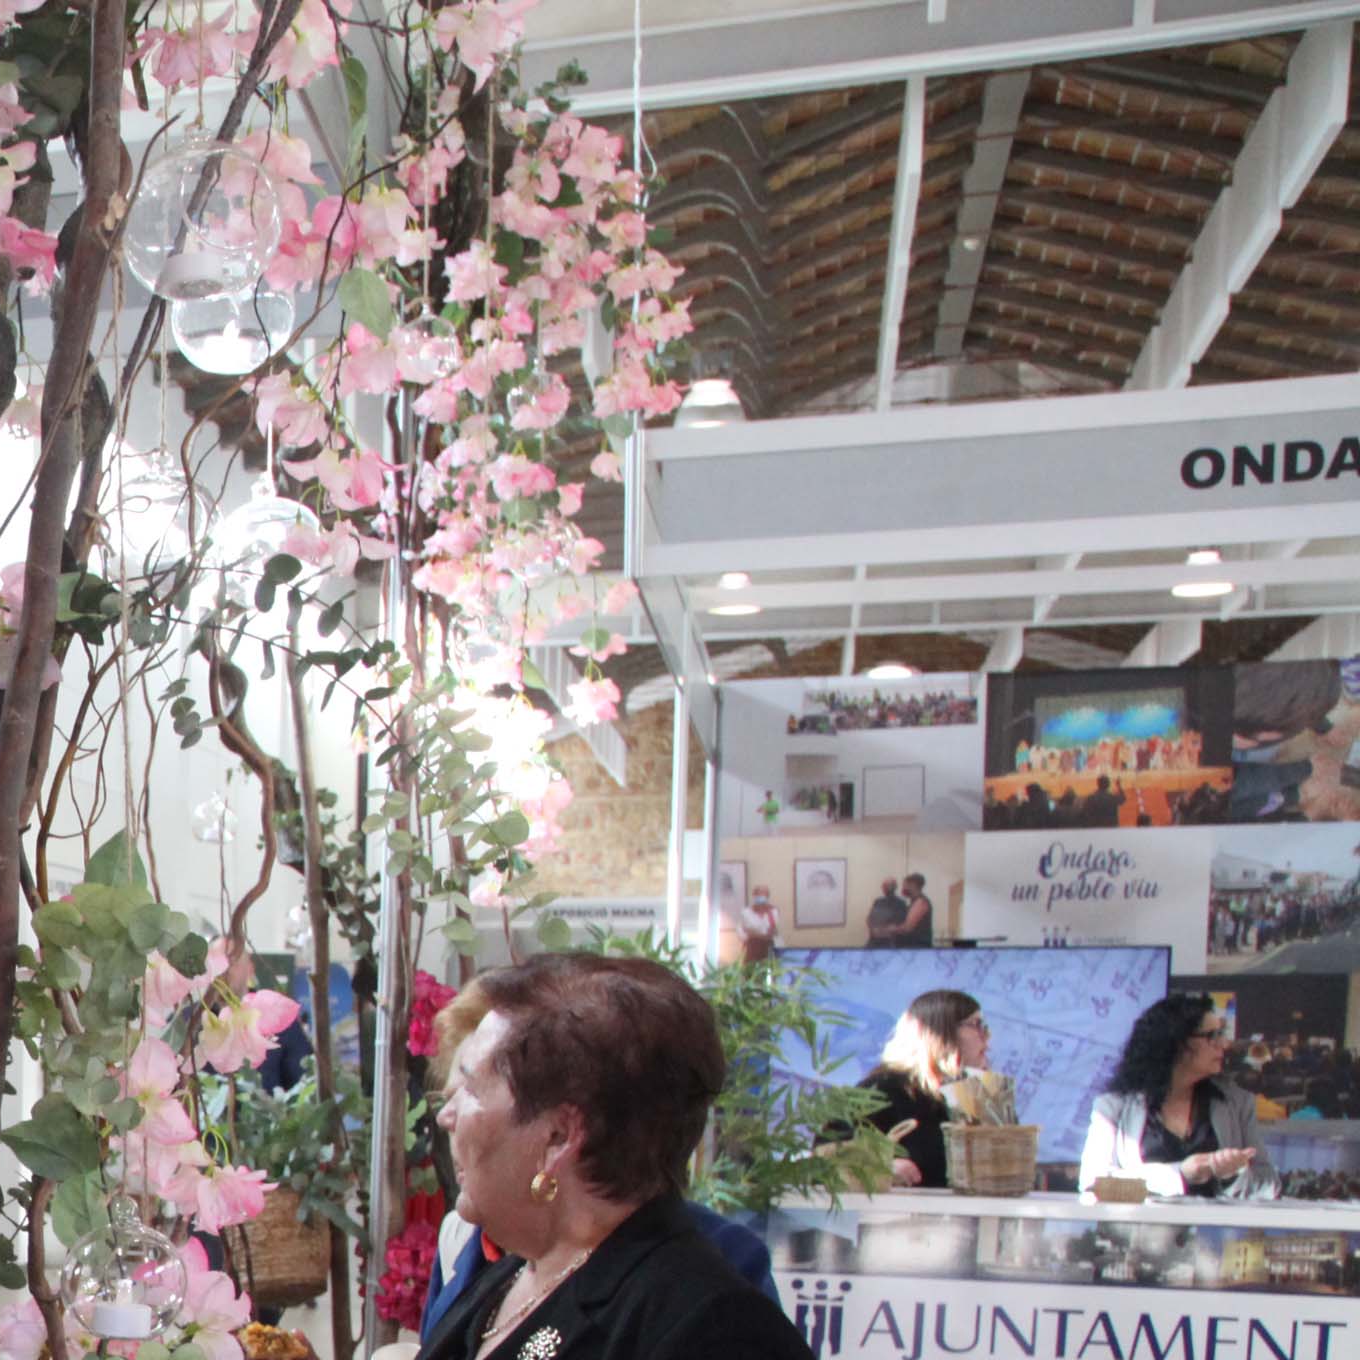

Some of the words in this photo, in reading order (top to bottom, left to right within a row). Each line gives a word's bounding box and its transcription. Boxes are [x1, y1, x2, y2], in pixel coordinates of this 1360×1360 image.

[1180, 436, 1360, 489] ONDA
[1011, 882, 1039, 901] un
[1046, 876, 1115, 912] poble
[1123, 878, 1159, 900] viu
